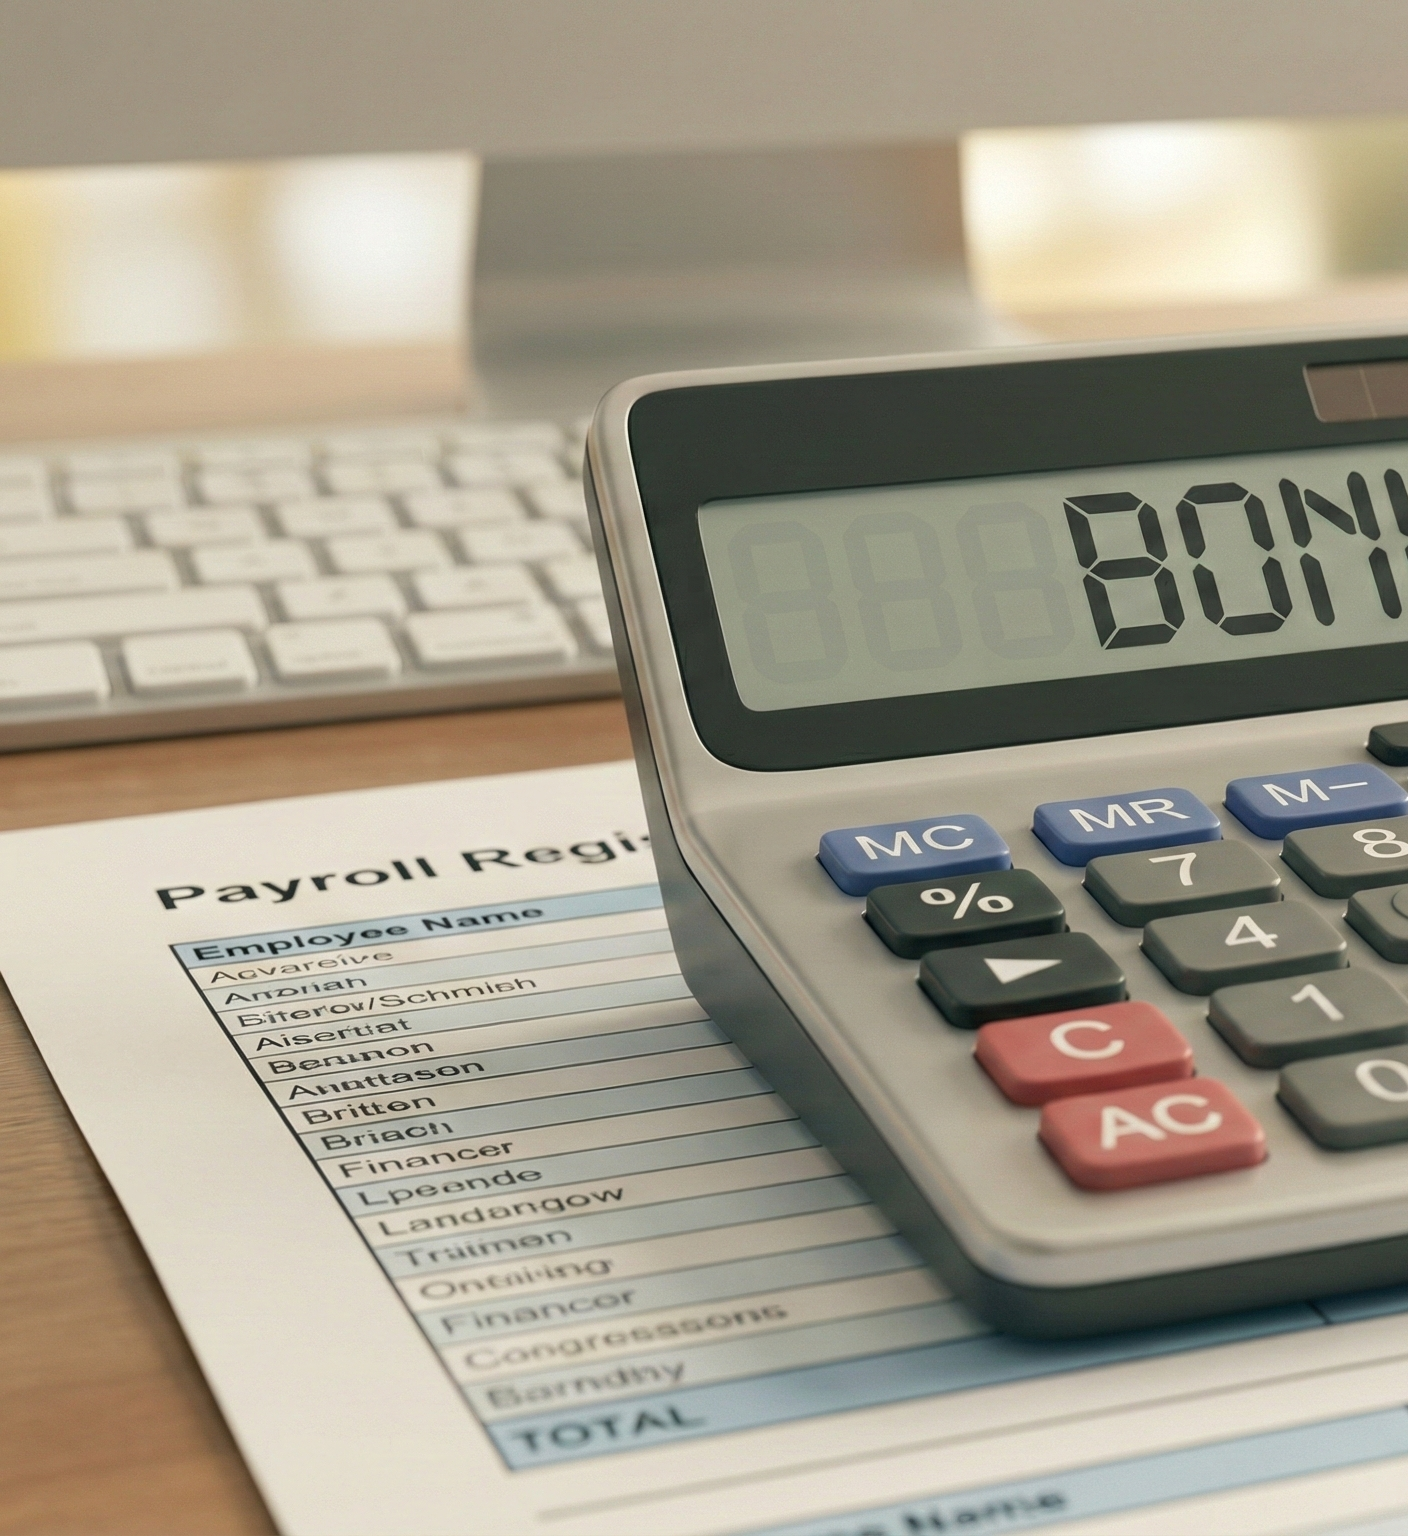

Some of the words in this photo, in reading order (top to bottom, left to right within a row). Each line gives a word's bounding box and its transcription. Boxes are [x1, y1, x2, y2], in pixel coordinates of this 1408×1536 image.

[1068, 798, 1191, 833] MR
[855, 825, 974, 860] MC
[155, 857, 437, 911] Payroll
[460, 830, 651, 873] Regi
[1148, 852, 1198, 887] 7
[920, 882, 1014, 920] %
[192, 924, 410, 962] Employee
[421, 906, 545, 932] Name
[1224, 915, 1279, 950] 4
[1290, 983, 1345, 1022] 1
[1049, 1019, 1126, 1061] C
[301, 1096, 437, 1126] Britten
[1099, 1093, 1225, 1151] AC
[338, 1142, 515, 1179] Financer
[513, 1406, 708, 1453] TOTAL
